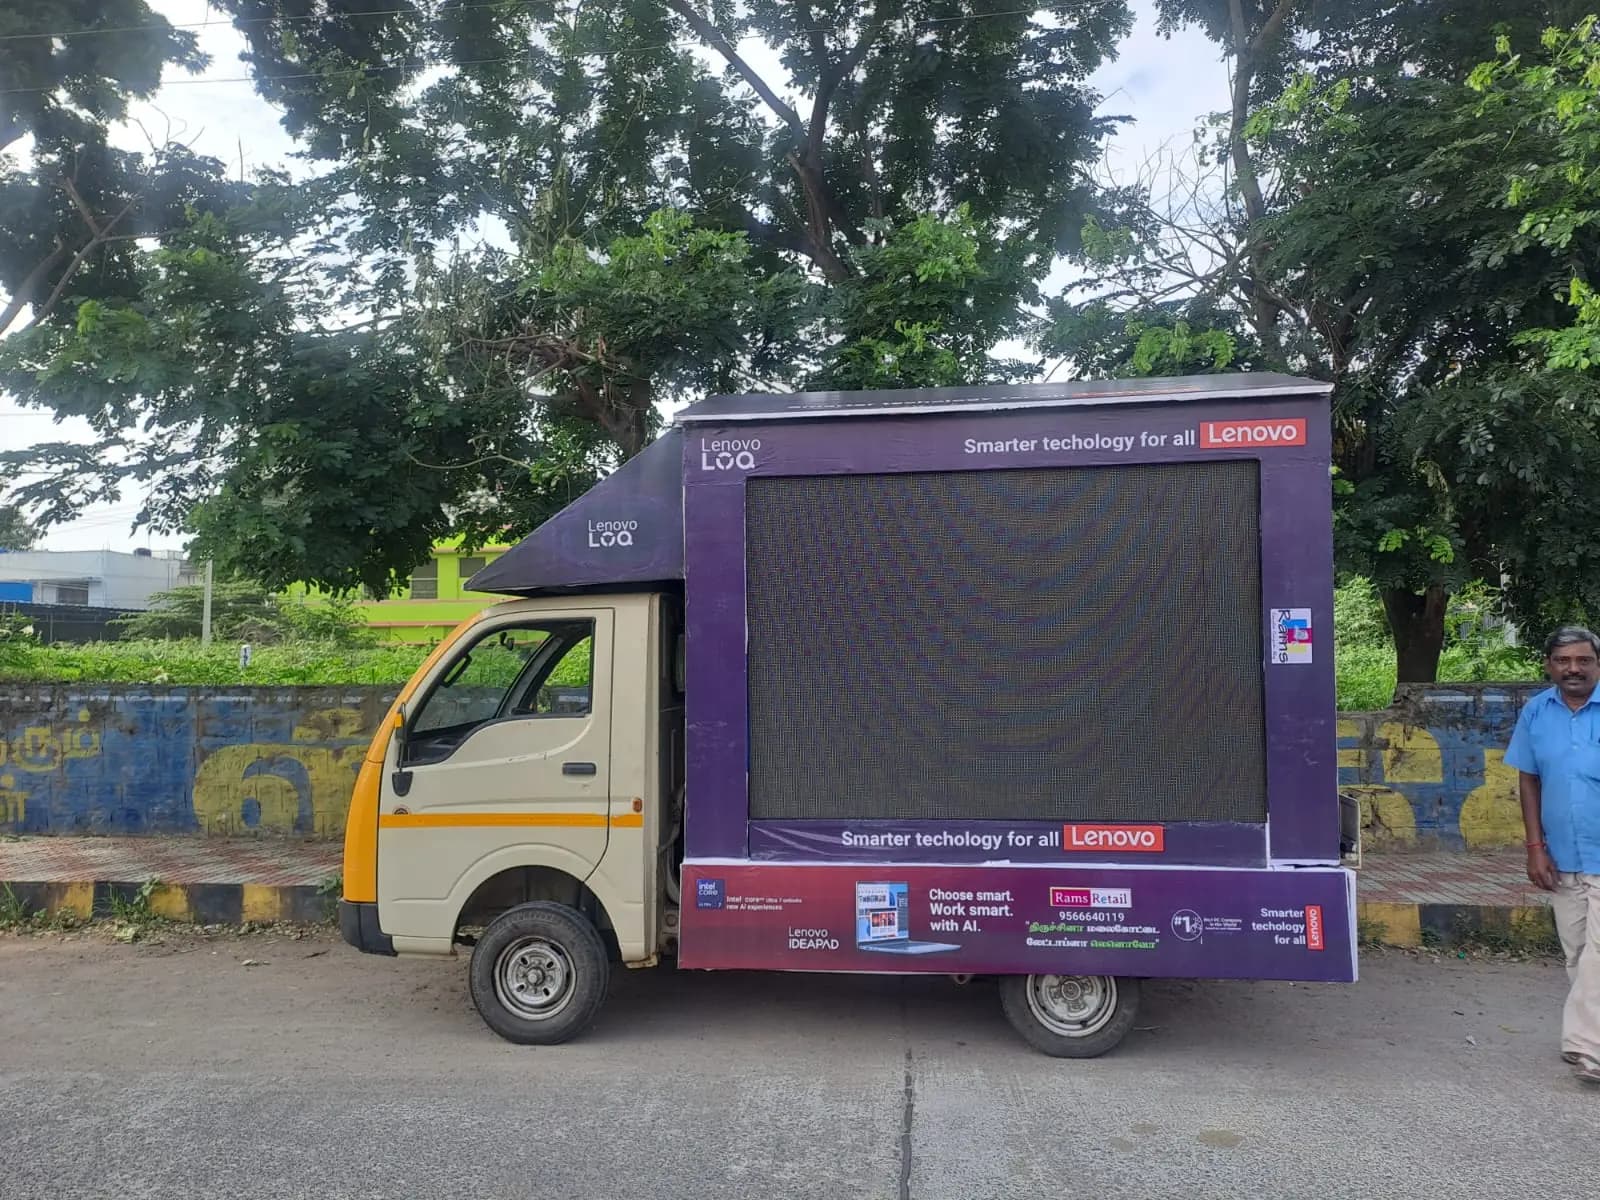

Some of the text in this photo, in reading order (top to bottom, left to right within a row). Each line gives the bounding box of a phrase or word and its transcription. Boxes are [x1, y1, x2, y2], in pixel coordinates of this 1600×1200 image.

[701, 437, 761, 452] Lenovo
[964, 423, 1297, 454] Smarter techology for all Lenovo
[701, 451, 756, 471] LOQ
[588, 519, 638, 532] Lenovo
[588, 531, 633, 547] LOQ
[1278, 609, 1291, 663] Rams
[841, 826, 1155, 850] Smarter techology for all Lenovo
[929, 888, 1014, 901] Choose smart.
[1055, 892, 1128, 905] Rams Retail
[929, 903, 1014, 917] Work smart.
[1059, 911, 1125, 922] 9566640119
[1260, 908, 1304, 918] Smarter
[930, 919, 981, 932] with AI.
[1174, 916, 1190, 933] #1
[1251, 921, 1305, 933] techology
[1310, 908, 1320, 947] Lenovo
[788, 926, 828, 937] Lenovo
[788, 938, 840, 950] IDEAPAD
[1274, 935, 1306, 945] for all
